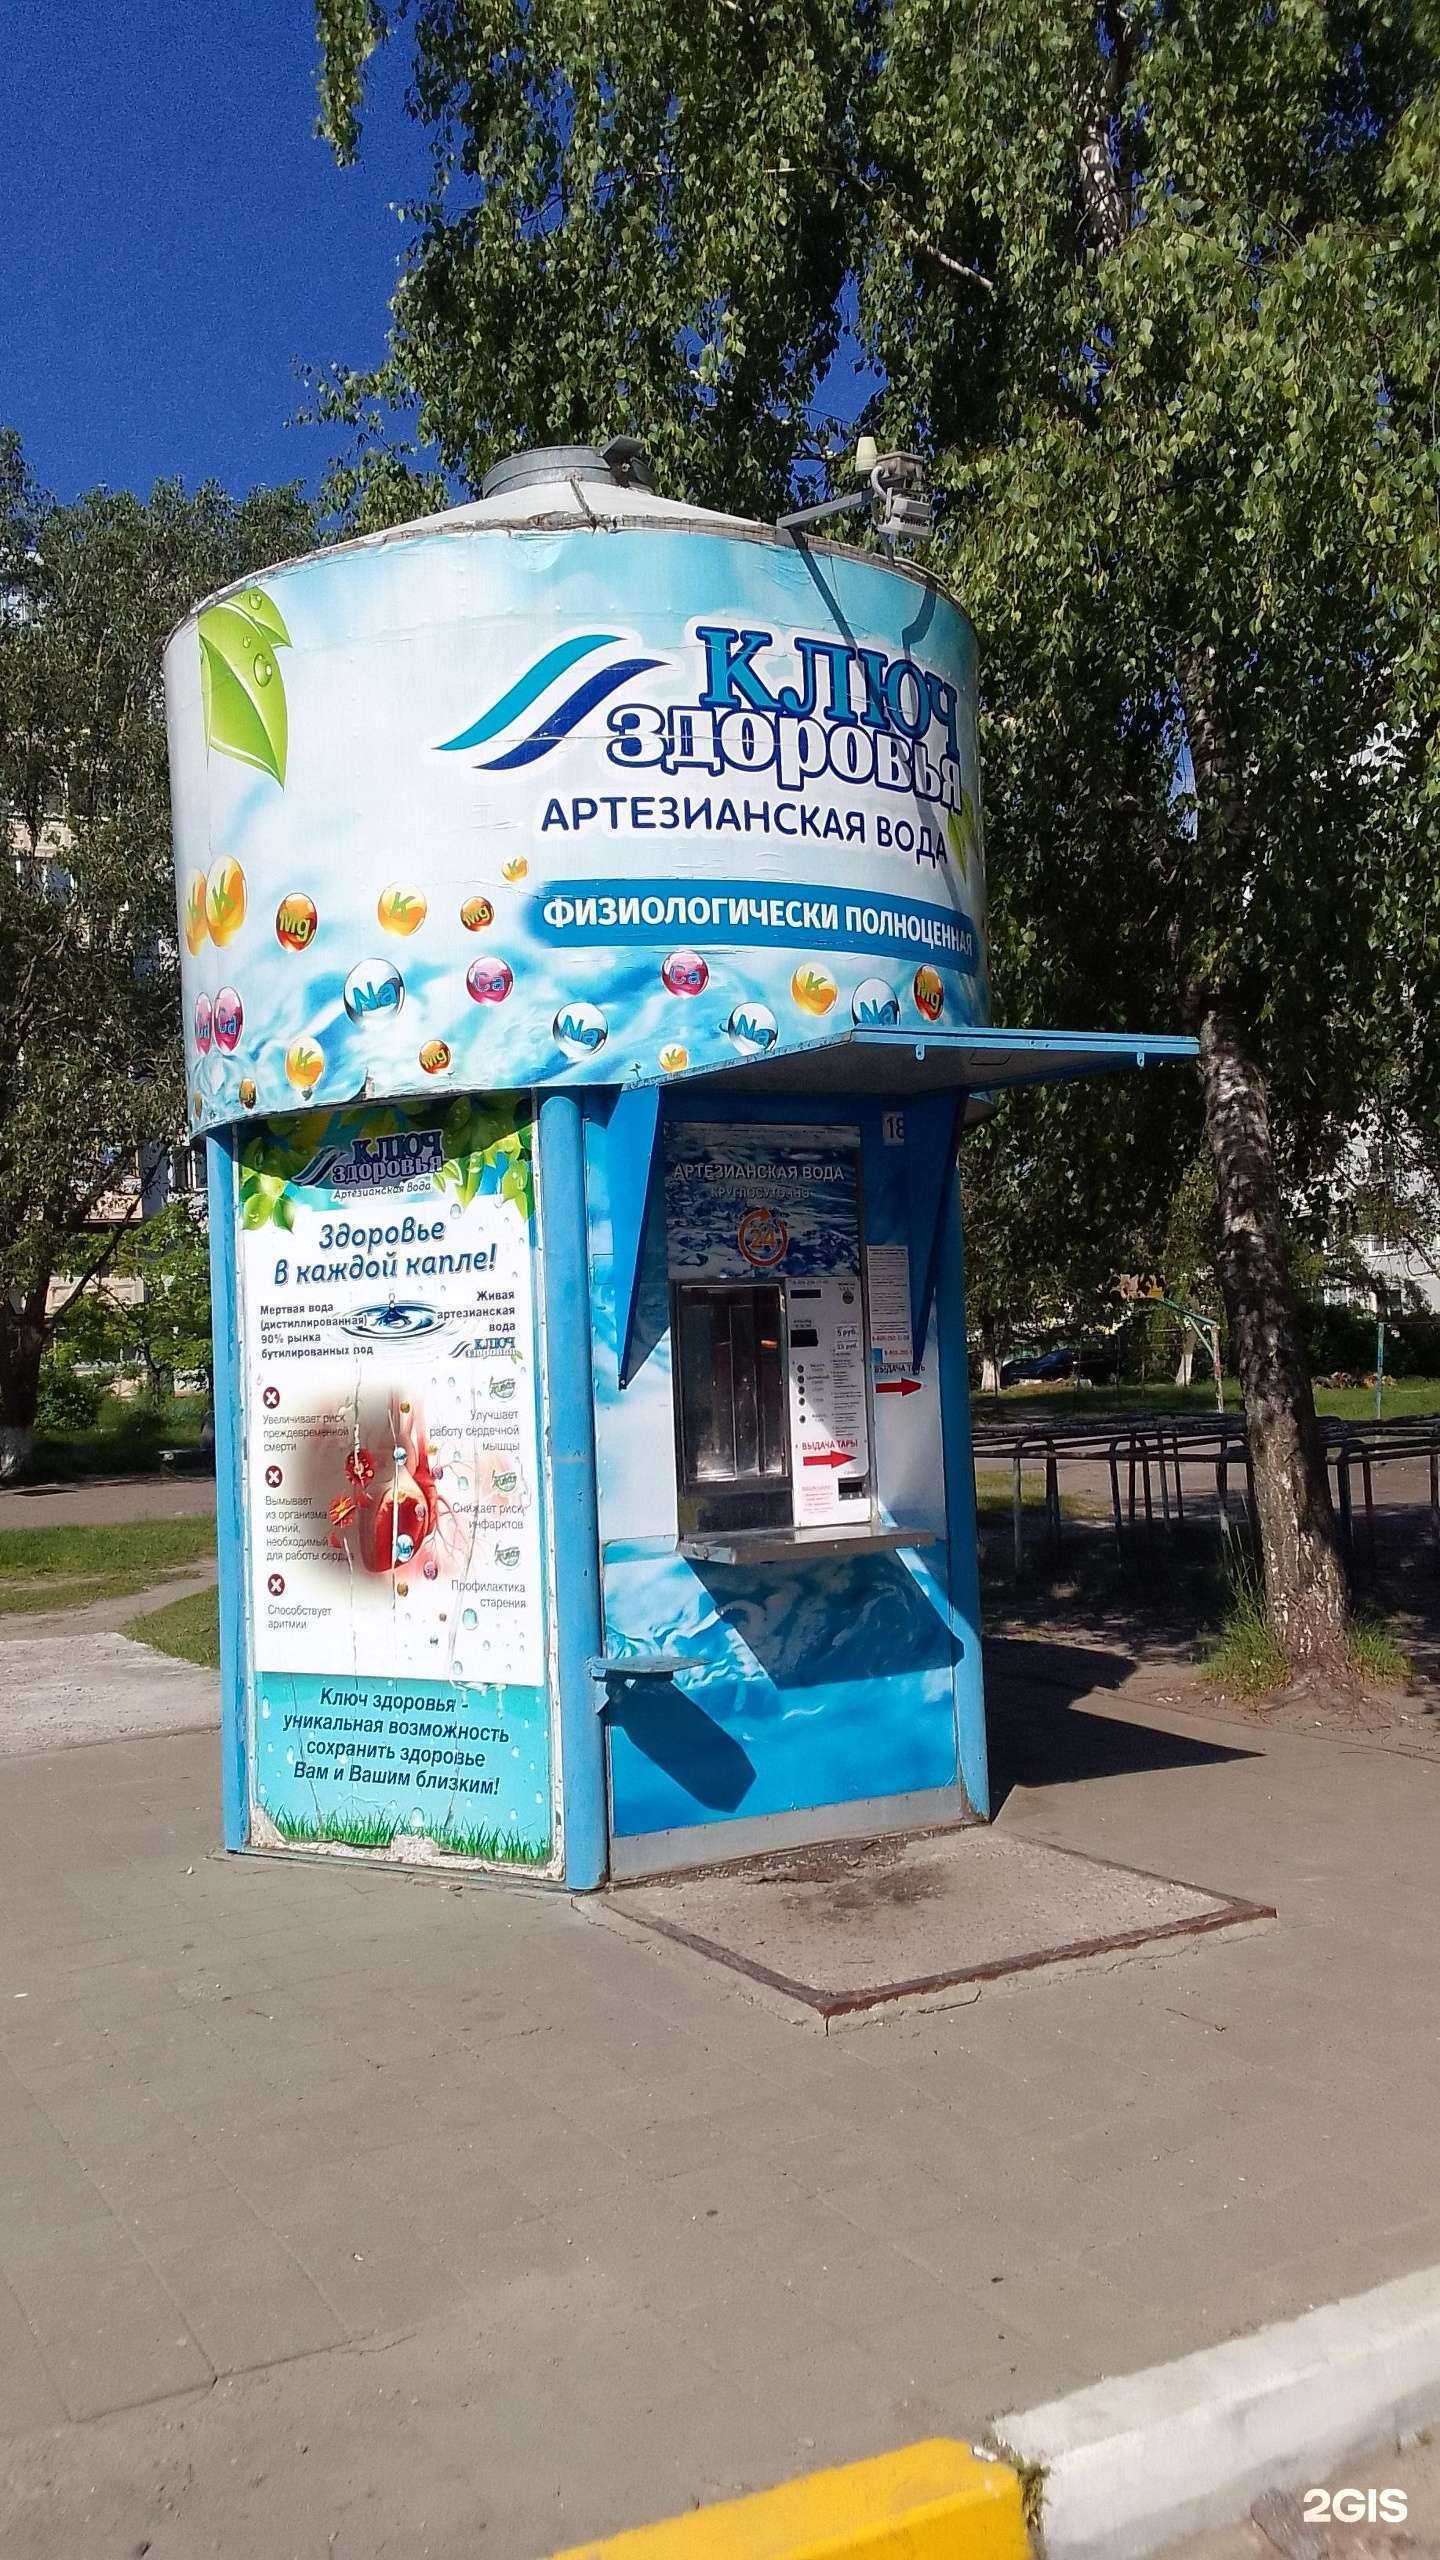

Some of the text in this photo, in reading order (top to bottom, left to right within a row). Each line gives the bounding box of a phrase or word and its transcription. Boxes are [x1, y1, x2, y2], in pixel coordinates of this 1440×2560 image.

[696, 625, 959, 756] КЛЮЧ
[541, 797, 948, 868] АРТЕЗИАНСКАЯ ВОДА
[464, 904, 490, 923] Mg
[279, 909, 311, 940] Mg
[543, 895, 974, 957] ФИЗИОЛОГИЧЕСКИ ПОЛНОЦЕННАЯ
[473, 970, 505, 991] Ca
[669, 964, 701, 985] Ca
[353, 976, 400, 1013] Na
[918, 978, 942, 1011] Mg
[561, 1014, 602, 1045] Na
[735, 1013, 770, 1046] Na
[351, 1130, 443, 1165] КЛЮЧ
[673, 1163, 845, 1183] АРТЕЗИАНСКАЯ ВОДА
[333, 1183, 405, 1200] Артезианская
[319, 1215, 446, 1253] Здоровье
[750, 1228, 777, 1249] 24
[296, 1251, 399, 1284] каждой
[406, 1243, 498, 1277] капле!
[477, 1290, 515, 1301] Живая
[260, 1303, 334, 1317] Мертвая вода
[437, 1306, 515, 1321] артезианская
[260, 1313, 368, 1332] (дистиллированная)
[489, 1322, 516, 1333] вода
[261, 1333, 321, 1345] 90% рынка
[261, 1346, 350, 1361] бутилированных
[262, 1413, 346, 1425] Увеличивает риск
[470, 1409, 519, 1422] Улучшает
[263, 1427, 350, 1440] преждевременной
[429, 1424, 520, 1439] работу сердечной
[263, 1442, 298, 1454] смерти
[482, 1441, 520, 1453] мышцы
[801, 1439, 858, 1451] ВЫДАЧА ТАРЫ
[265, 1495, 313, 1506] Вымывает
[265, 1511, 328, 1521] из организма
[452, 1502, 497, 1515] Снижает
[468, 1519, 525, 1533] инфарктов
[266, 1536, 329, 1548] необходимый
[266, 1552, 283, 1561] для
[285, 1549, 320, 1562] работы
[450, 1579, 526, 1594] Профилактика
[267, 1604, 332, 1617] Способствует
[479, 1597, 527, 1610] старения
[267, 1619, 307, 1631] аритмии
[319, 1687, 369, 1707] Ключ
[373, 1692, 456, 1714] здоровья
[282, 1713, 510, 1743] уникальная возможность
[306, 1740, 486, 1768] сохранить здоровье
[293, 1761, 501, 1796] Вам и Вашим близким!
